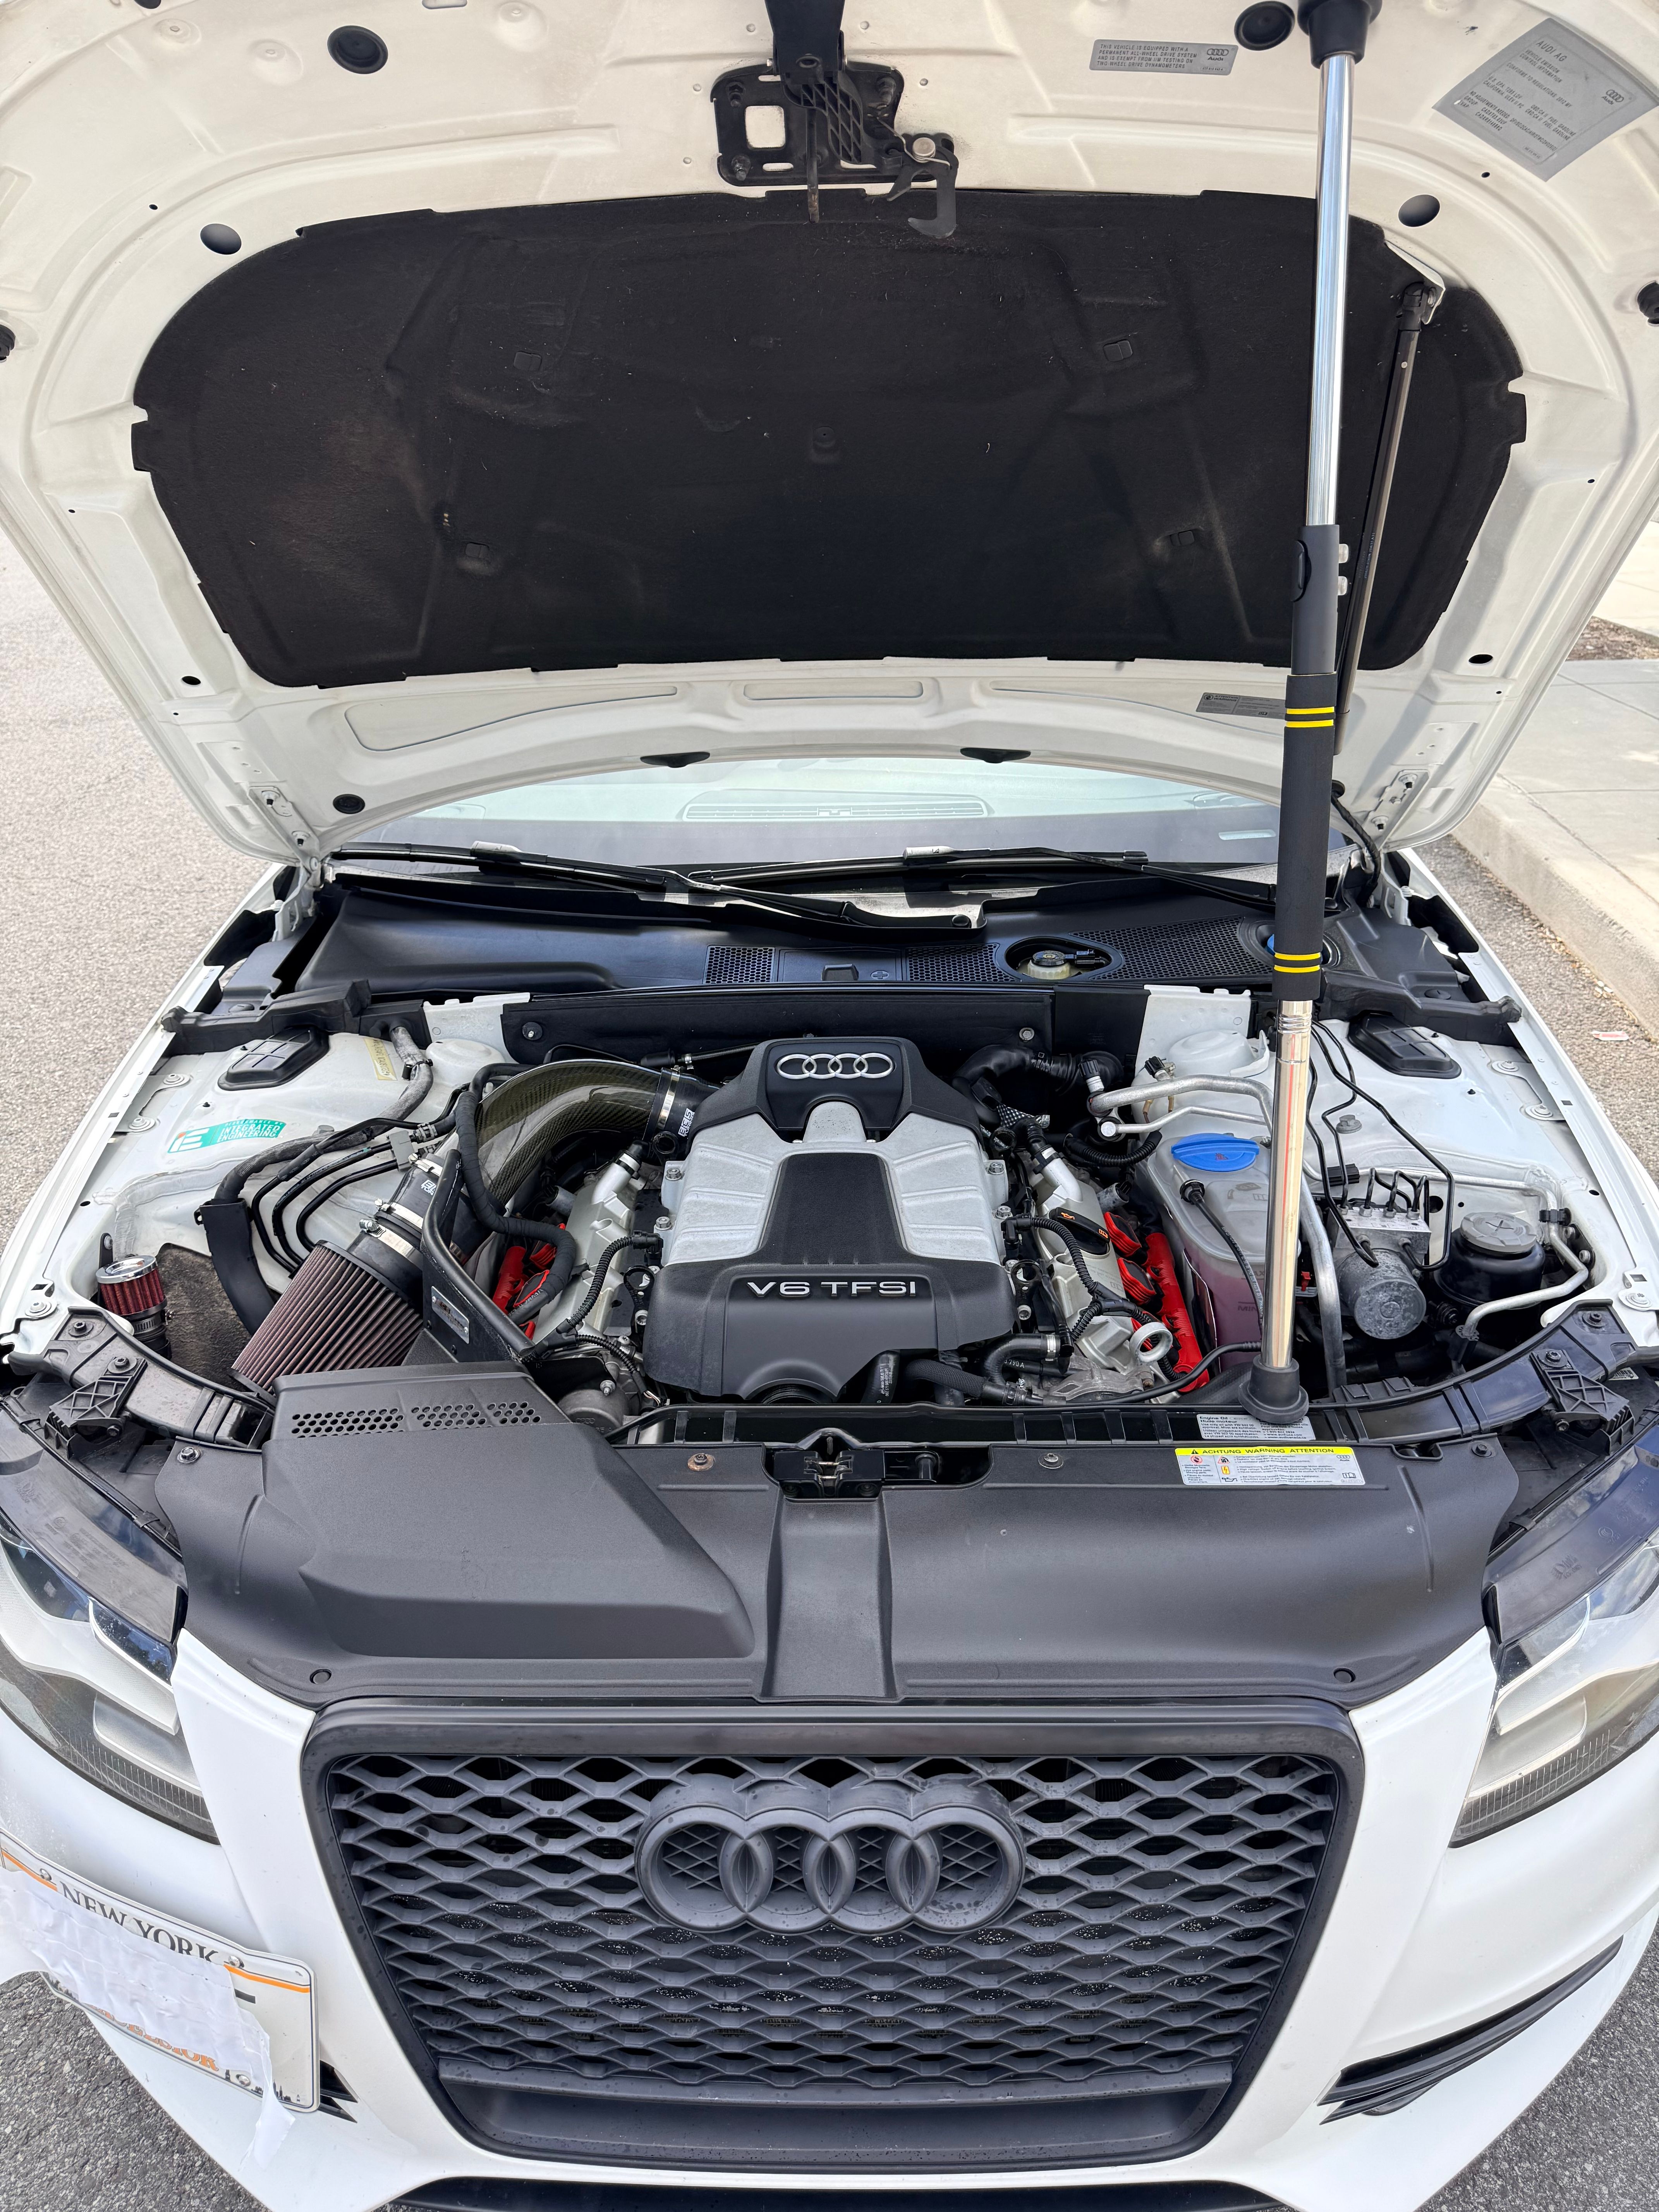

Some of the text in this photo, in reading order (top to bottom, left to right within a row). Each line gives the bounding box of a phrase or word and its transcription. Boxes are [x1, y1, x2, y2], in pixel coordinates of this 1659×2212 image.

[1535, 39, 1568, 62] AUDI AG
[1519, 53, 1563, 83] CONTROL INFORMATION
[1525, 49, 1560, 73] VEHICLE EMISSION
[1506, 62, 1528, 77] CONFORMS
[1474, 93, 1498, 110] ADJUSTMENTS
[1601, 96, 1614, 105] Audi
[1552, 127, 1571, 140] GASOLINE
[1557, 123, 1577, 136] GASOLINE
[221, 1123, 280, 1135] INTEGRATED
[678, 1108, 692, 1137] ECS
[217, 1130, 278, 1143] ENGINEERING
[747, 1281, 915, 1297] V6 TFSI
[60, 1881, 218, 1963] NEW YORK
